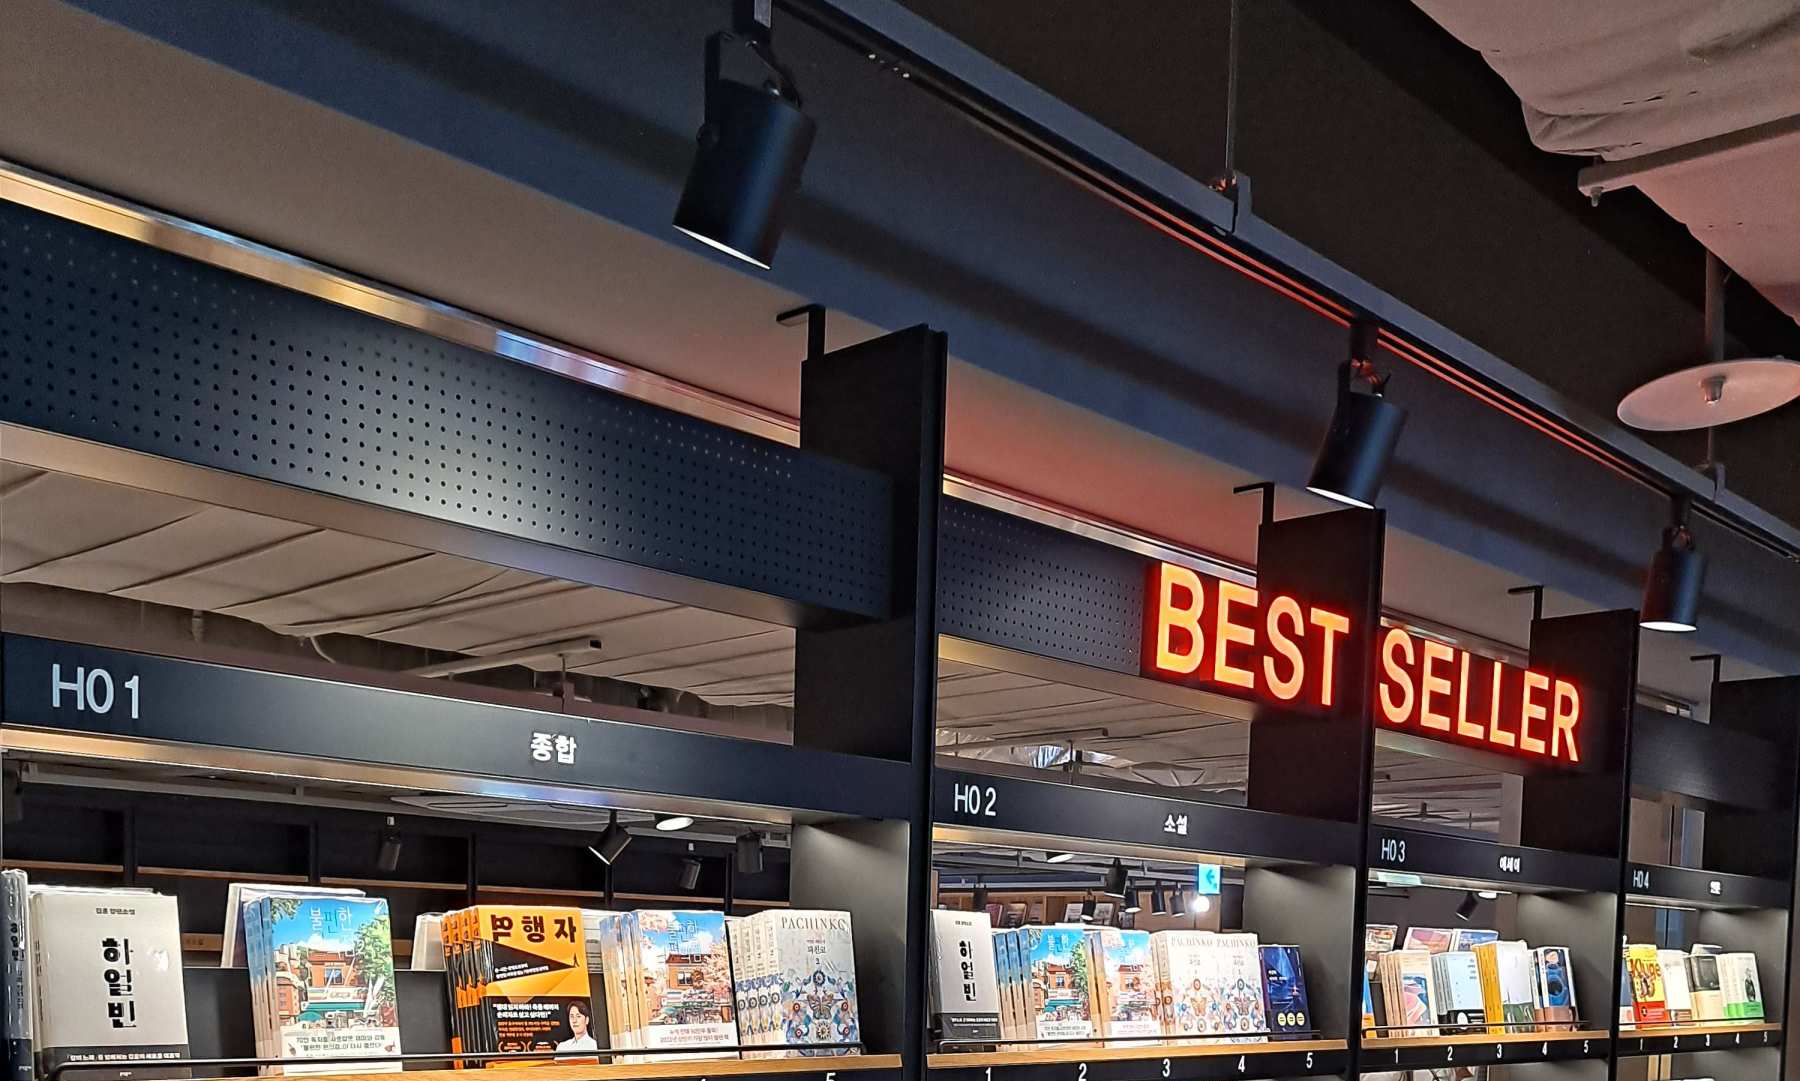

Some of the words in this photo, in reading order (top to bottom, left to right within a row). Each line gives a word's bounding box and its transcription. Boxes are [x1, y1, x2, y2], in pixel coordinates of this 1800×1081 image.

[1156, 562, 1349, 706] BEST
[1379, 628, 1580, 762] SELLER
[530, 731, 578, 766] 종합
[1163, 814, 1189, 835] 소설
[781, 916, 849, 930] PACHINKO
[958, 939, 977, 1002] 하얼빈
[102, 937, 137, 1029] 하얼빈
[1496, 1043, 1503, 1059] 3
[1541, 1041, 1548, 1056] 4
[1583, 1039, 1589, 1054] 5
[1673, 1036, 1679, 1049] 2
[1305, 1052, 1314, 1069] 5
[1394, 1048, 1399, 1064] 1
[1447, 1045, 1453, 1062] 2
[1162, 1058, 1171, 1078] 3
[1237, 1055, 1246, 1073] 4
